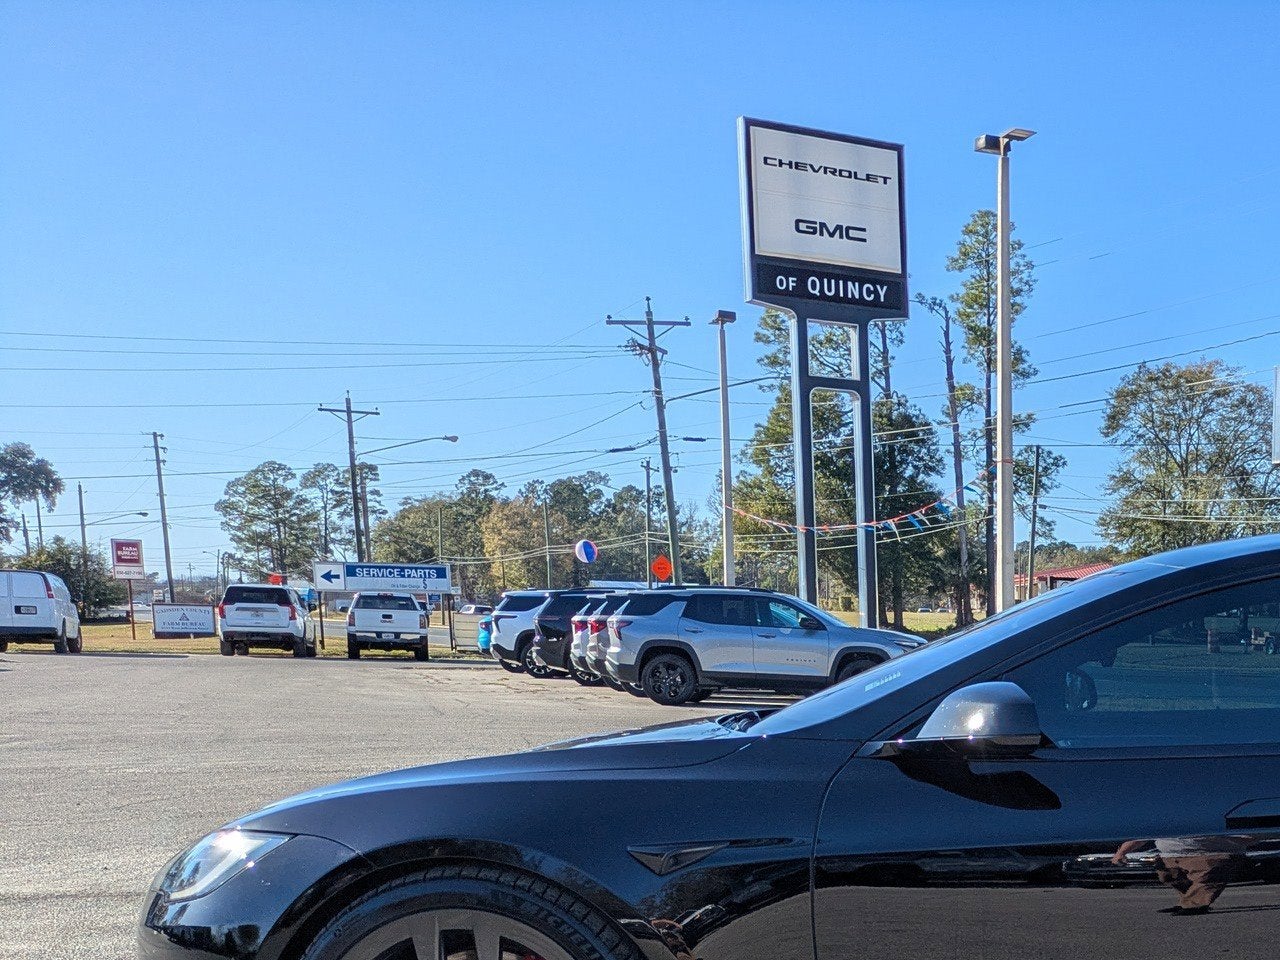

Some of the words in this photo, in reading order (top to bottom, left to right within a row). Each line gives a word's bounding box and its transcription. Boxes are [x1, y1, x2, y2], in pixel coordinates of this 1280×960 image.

[763, 156, 892, 185] CHEVROLET
[794, 218, 867, 243] GMC
[775, 275, 797, 291] OF
[807, 276, 888, 302] QUINCY
[355, 567, 437, 579] SERVICE-PARTS
